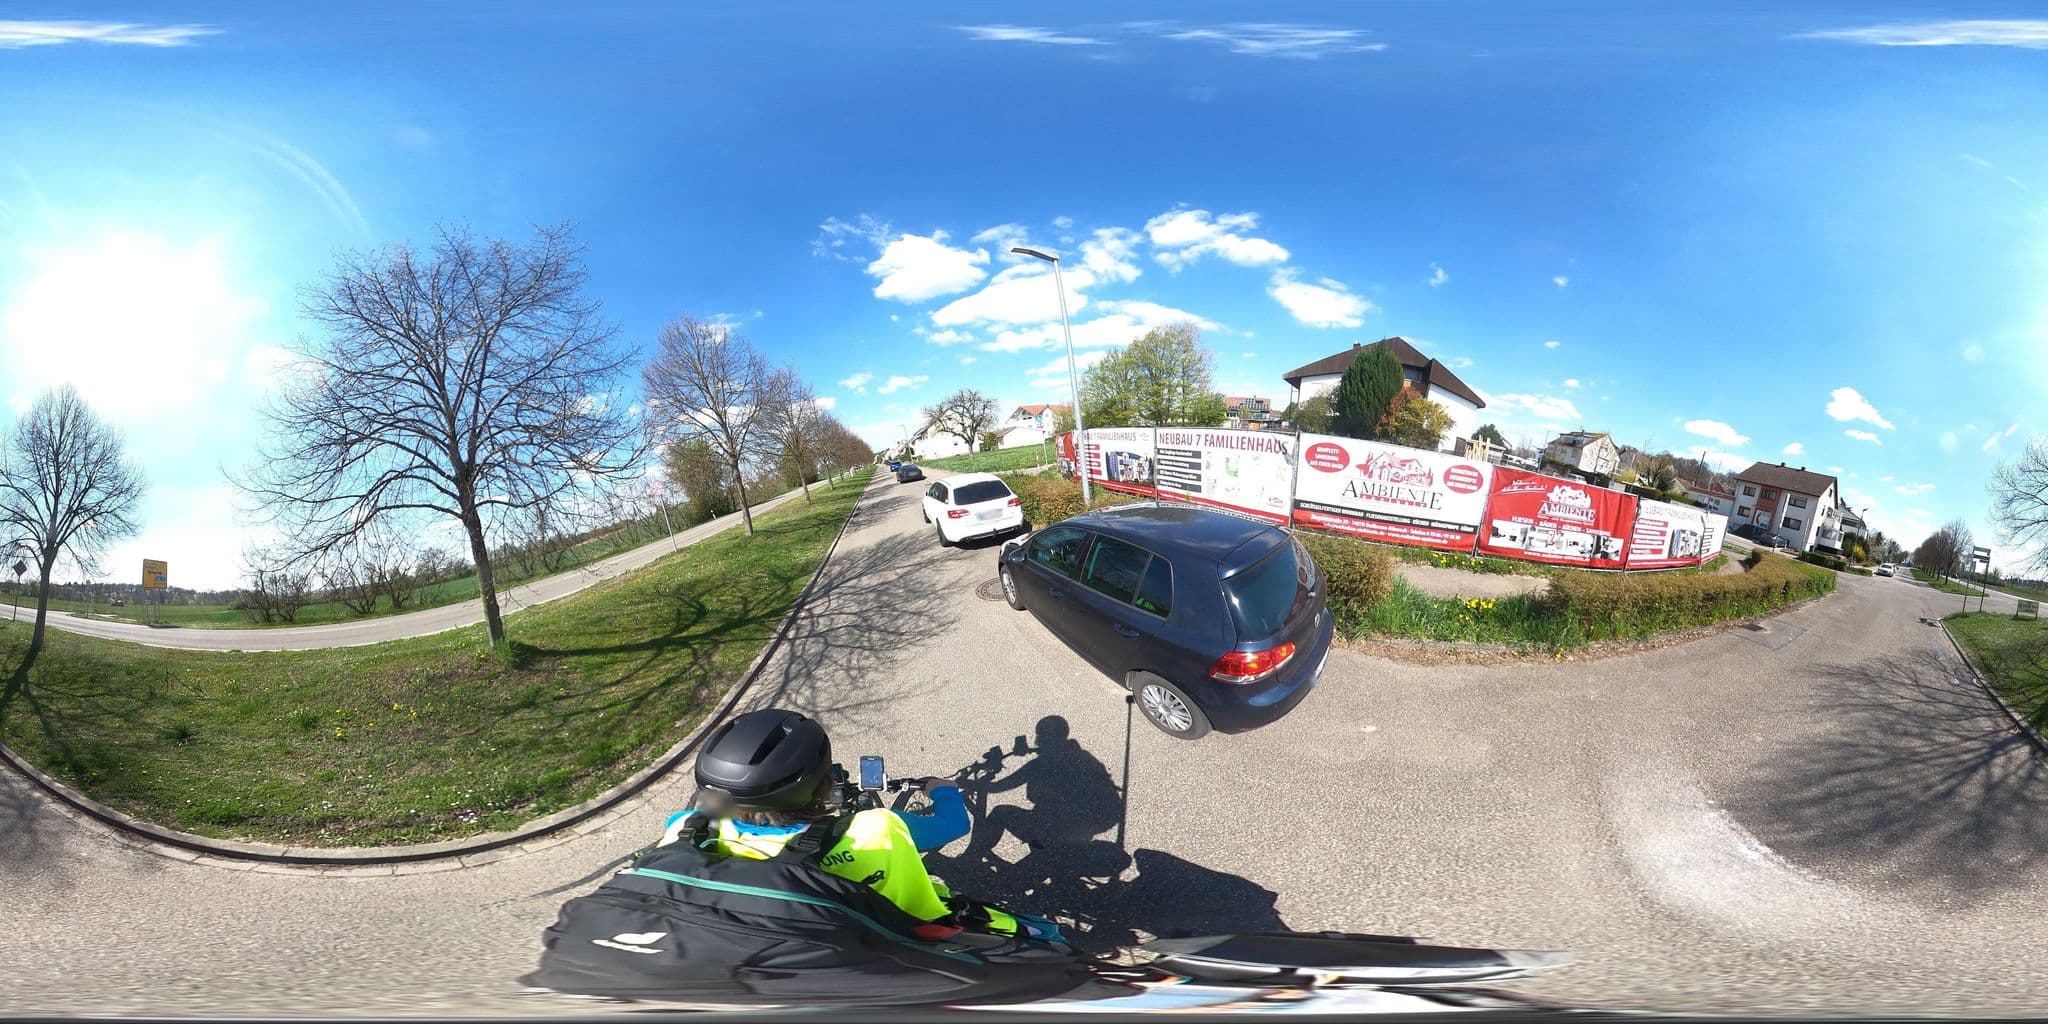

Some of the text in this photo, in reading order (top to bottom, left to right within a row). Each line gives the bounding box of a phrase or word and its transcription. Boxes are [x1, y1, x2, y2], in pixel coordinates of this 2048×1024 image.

[1097, 431, 1137, 442] FAMILIENHAUS
[1159, 432, 1193, 446] NEUBAU
[1195, 434, 1201, 446] 7
[1204, 433, 1288, 455] FAMILIENHAUS
[1342, 480, 1444, 511] AMBIENTE
[1538, 502, 1596, 521] AMBIENTE
[820, 850, 855, 867] UNG
